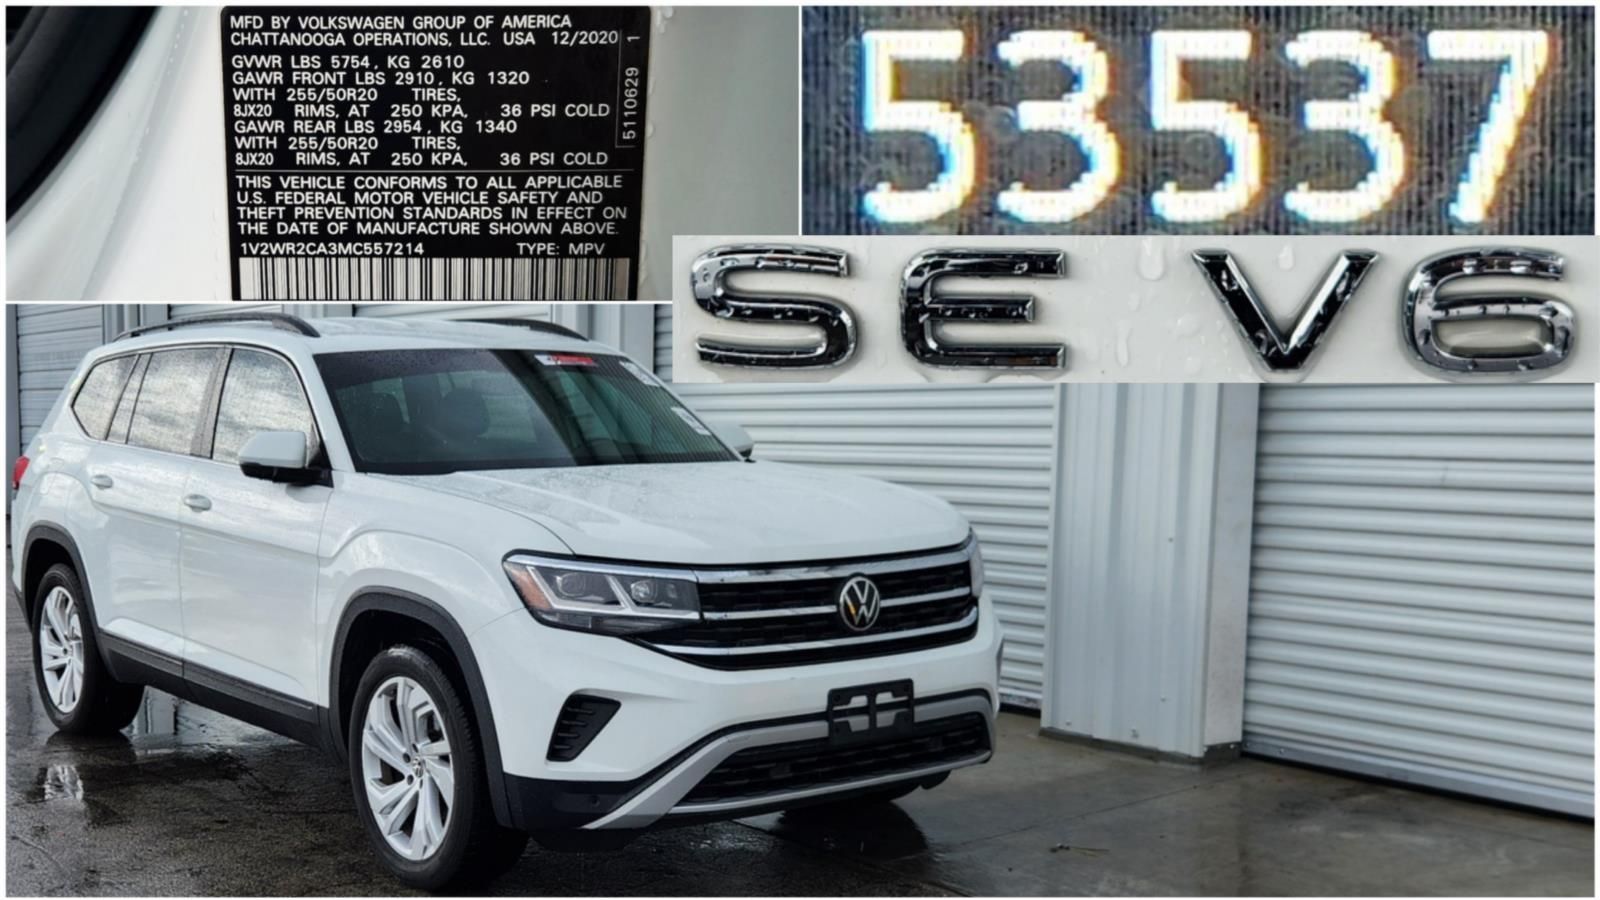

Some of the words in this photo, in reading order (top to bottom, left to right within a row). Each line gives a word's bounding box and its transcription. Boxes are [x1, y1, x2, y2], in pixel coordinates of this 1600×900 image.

[231, 16, 263, 29] MFD
[272, 16, 290, 29] BY
[298, 16, 404, 29] VOLKSWAGEN
[413, 16, 466, 29] GROUP
[474, 15, 494, 28] OF
[502, 15, 572, 28] AMERICA
[231, 32, 345, 45] CHATTANOOGA
[353, 32, 451, 46] OPERATIONS,
[461, 32, 490, 45] LLC.
[504, 32, 535, 45] USA
[552, 31, 618, 46] 12/2020
[232, 55, 282, 68] GVWR
[291, 55, 321, 68] LBS
[331, 55, 378, 69] 5754,
[388, 55, 410, 68] KG
[421, 55, 464, 68] 2610
[233, 71, 283, 84] GAWR
[293, 72, 346, 85] FRONT
[356, 72, 385, 85] LBS
[396, 72, 442, 85] 2910,
[452, 72, 474, 85] KG
[488, 71, 529, 84] 1320
[233, 88, 275, 100] WITH
[287, 88, 377, 103] 255/50R20
[412, 88, 460, 102] TIRES,
[622, 67, 640, 140] 5110629
[234, 104, 274, 117] 8JX20
[295, 104, 339, 120] RIMS,
[346, 104, 372, 117] AT
[391, 104, 422, 117] 250
[432, 104, 467, 120] KPA,
[501, 104, 522, 117] 36
[531, 104, 555, 117] PSI
[565, 104, 609, 117] COLD
[235, 120, 284, 133] GAWR
[294, 120, 335, 133] REAR
[345, 120, 374, 133] LBS
[384, 120, 433, 136] 2954,
[440, 120, 463, 133] KG
[476, 120, 517, 133] 1340
[862, 30, 1550, 223] 53537
[235, 136, 277, 149] WITH
[288, 137, 378, 153] 255/50R20
[412, 136, 460, 152] TIRES,
[236, 153, 274, 165] 8JX20
[296, 152, 340, 166] RIMS,
[349, 152, 370, 165] AT
[392, 153, 422, 165] 250
[432, 152, 467, 166] KPA,
[500, 153, 520, 165] 36
[530, 152, 554, 165] PSI
[564, 152, 608, 165] COLD
[236, 175, 271, 188] THIS
[280, 176, 345, 189] VEHICLE
[354, 176, 447, 189] CONFORMS
[456, 176, 478, 189] TO
[486, 176, 516, 189] ALL
[524, 175, 621, 188] APPLICABLE
[237, 191, 266, 204] U.S.
[276, 191, 346, 204] FEDERAL
[355, 191, 414, 204] MOTOR
[422, 191, 488, 204] VEHICLE
[498, 191, 558, 204] SAFETY
[567, 191, 602, 203] AND
[237, 207, 286, 219] THEFT
[295, 207, 394, 219] PREVENTION
[403, 207, 502, 219] STANDARDS
[512, 207, 527, 219] IN
[537, 207, 594, 219] EFFECT
[603, 207, 626, 219] ON
[238, 222, 268, 234] THE
[277, 222, 318, 234] DATE
[327, 222, 348, 235] OF
[357, 222, 480, 235] MANUFACTURE
[489, 222, 551, 235] SHOWN
[561, 222, 618, 234] ABOVE.
[240, 242, 424, 255] 1V2WR2CA3MC557214
[517, 243, 559, 255] TYPE:
[569, 243, 604, 254] MPV
[690, 242, 1071, 370] SE
[1191, 248, 1575, 374] V6
